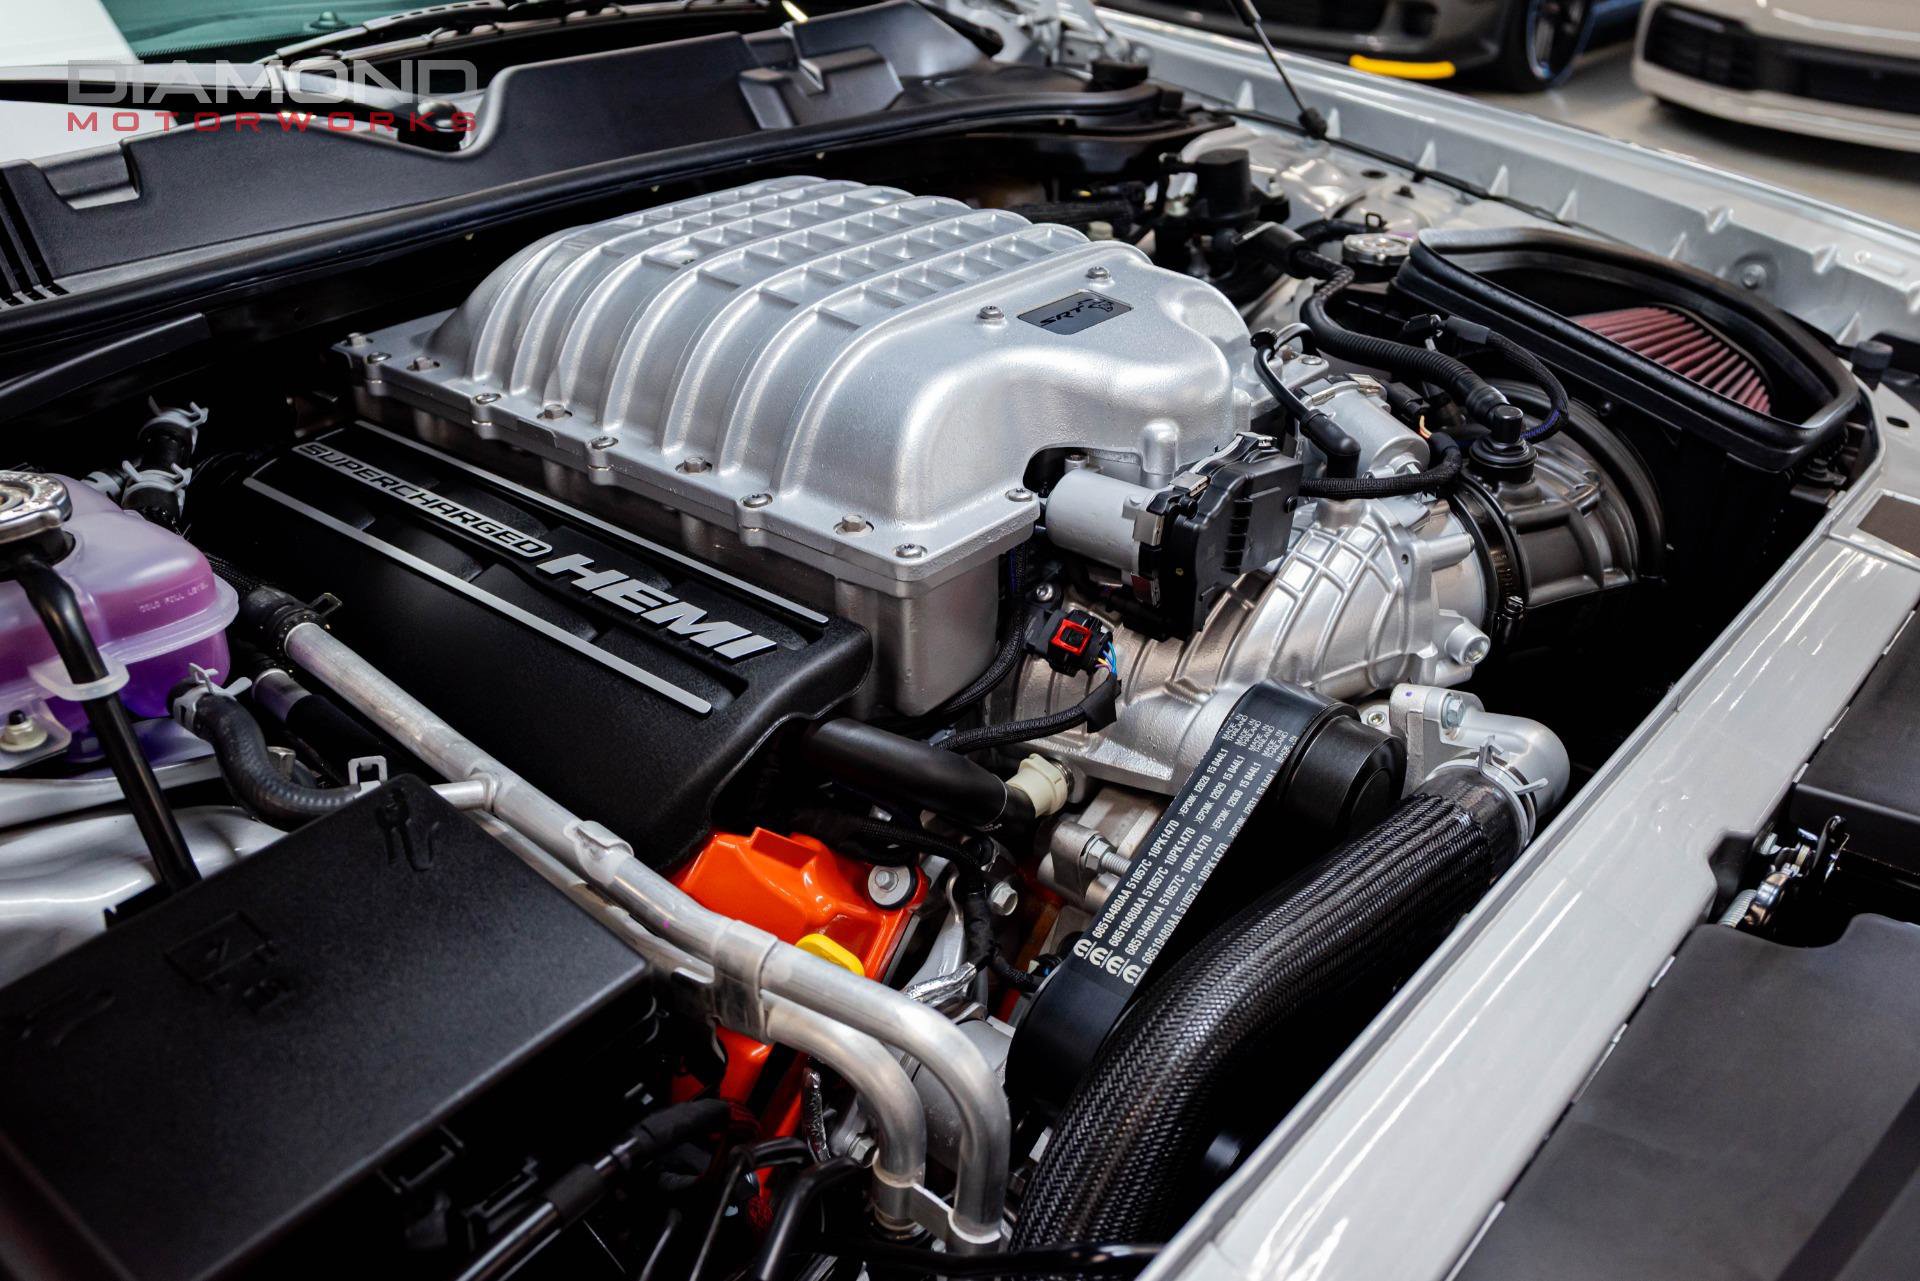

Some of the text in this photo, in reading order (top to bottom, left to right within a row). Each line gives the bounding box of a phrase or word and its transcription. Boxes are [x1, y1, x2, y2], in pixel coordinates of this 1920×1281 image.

[298, 444, 776, 660] SUPERCHARGED HEMI
[1222, 723, 1236, 740] MADE
[1226, 715, 1248, 741] THAILAND
[1235, 728, 1250, 745] MADE
[1240, 720, 1261, 746] THAILAND
[1253, 726, 1275, 752] THAILAND
[1248, 733, 1263, 751] MADE
[1262, 739, 1277, 757] MADE
[1267, 732, 1288, 758] THAILAND
[1275, 745, 1290, 762] MADE
[1092, 890, 1132, 938] 68519480AA
[1128, 859, 1152, 890] 51057C
[1148, 820, 1180, 858] 10PK1470
[1207, 765, 1216, 774] 15
[1109, 897, 1148, 947] 68519480AA
[1143, 866, 1168, 897] 51057C
[1164, 827, 1196, 865] 10PK1470
[1222, 772, 1233, 781] 15
[1125, 906, 1165, 956] 68519480AA
[1159, 874, 1185, 906] 51057C
[1181, 835, 1213, 874] 10PK1470
[1240, 780, 1249, 788] 15
